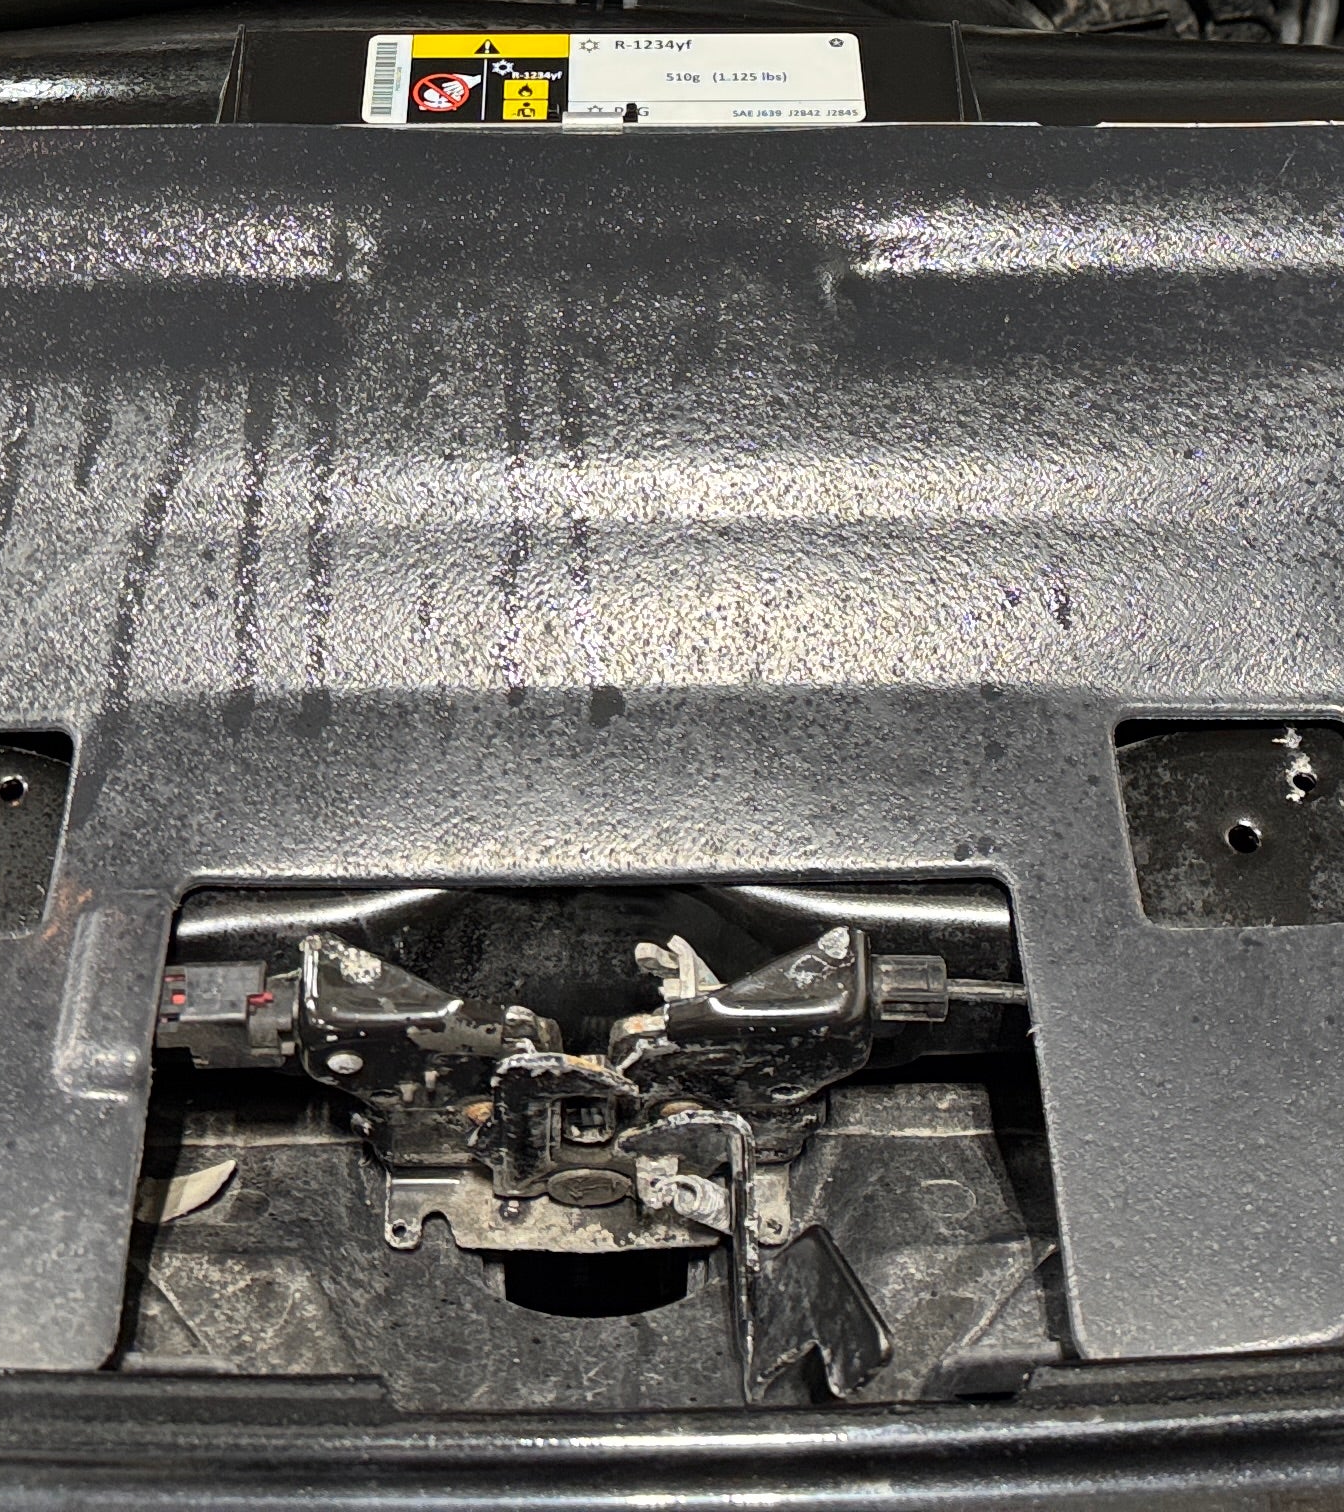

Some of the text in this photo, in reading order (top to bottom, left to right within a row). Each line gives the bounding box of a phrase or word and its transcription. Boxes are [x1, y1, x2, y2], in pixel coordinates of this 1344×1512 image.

[614, 39, 693, 52] R-1234yf
[511, 70, 563, 81] R-1234yf
[666, 71, 788, 84] 510g (1.125 lbs)
[614, 106, 650, 117] PG
[732, 108, 859, 118] SAE J639 J2842 J2845
